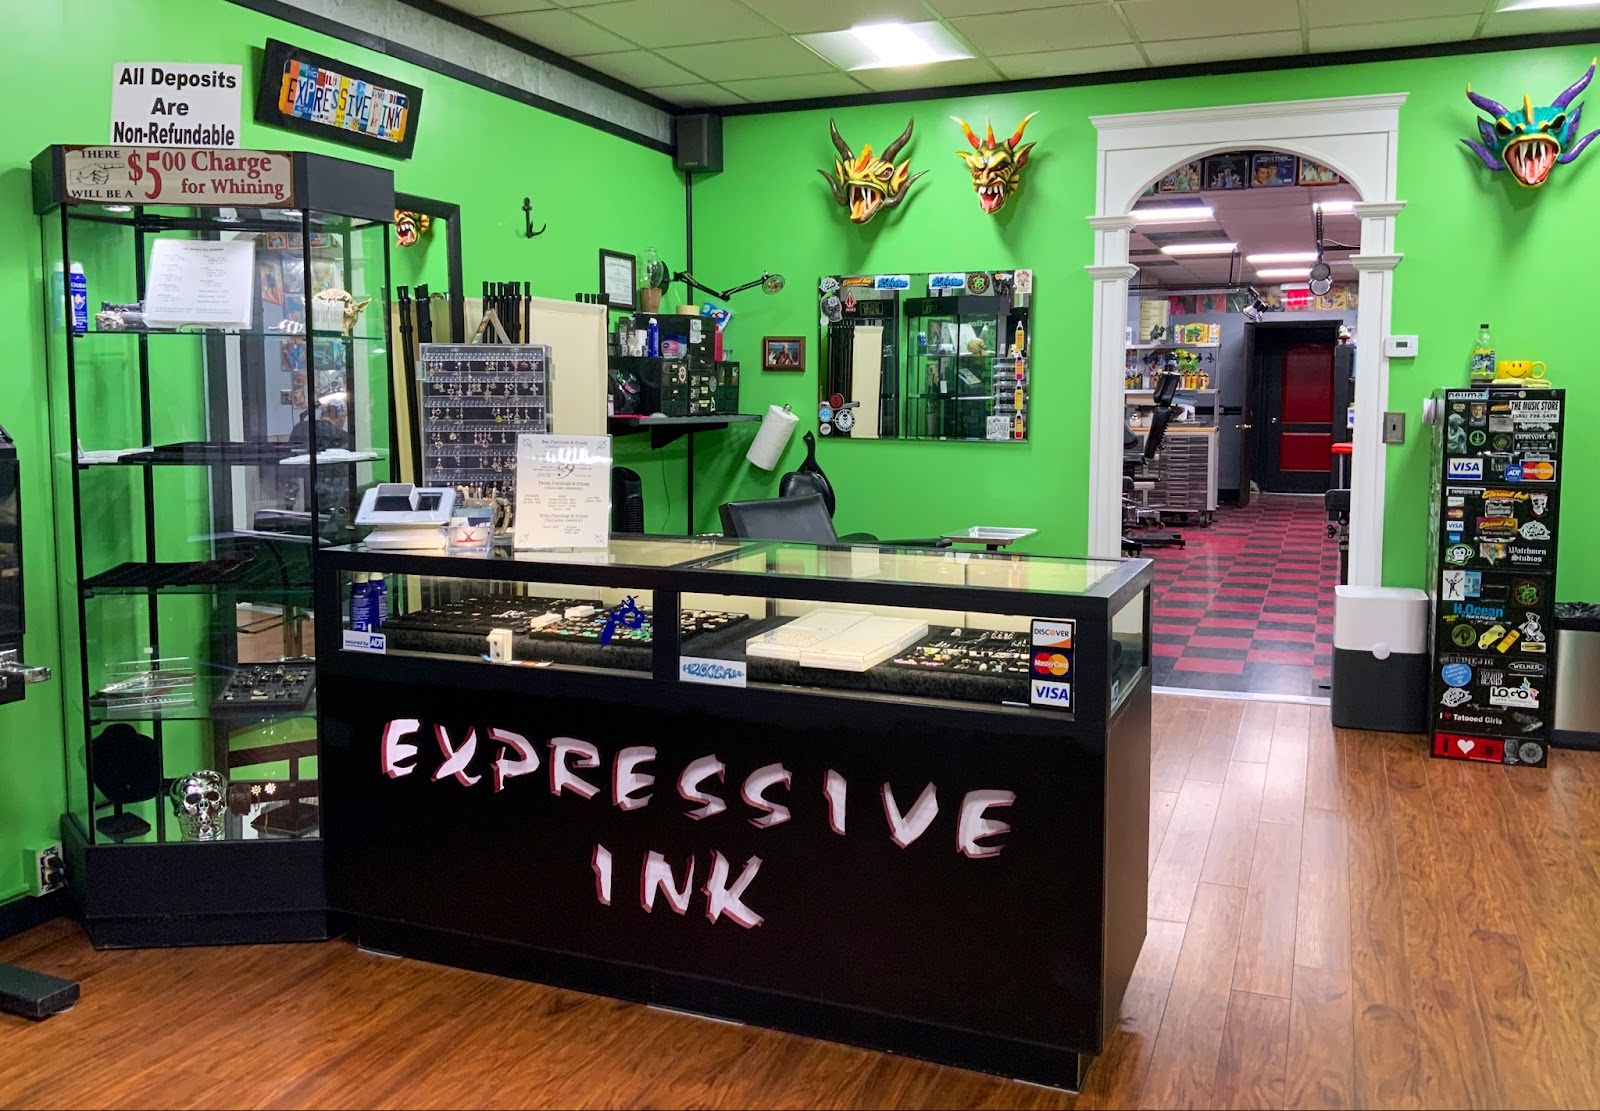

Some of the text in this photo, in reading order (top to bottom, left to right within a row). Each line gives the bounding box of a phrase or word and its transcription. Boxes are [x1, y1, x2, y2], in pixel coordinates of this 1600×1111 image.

[119, 67, 237, 91] All Deposits
[150, 97, 190, 116] Are
[287, 77, 404, 130] EXPRESSIVE INK
[113, 121, 235, 146] Non-Refundable
[80, 149, 121, 159] THERE
[190, 150, 272, 179] Charge
[71, 189, 134, 199] WILL BE A
[181, 178, 285, 200] for Whining
[1448, 391, 1483, 399] neuma
[1511, 401, 1522, 411] THE
[1522, 401, 1540, 411] MUSIC
[1541, 401, 1559, 411] STORE
[1453, 462, 1479, 471] VISA
[1508, 546, 1547, 555] Watchmen
[1034, 628, 1069, 637] DISCOVER
[370, 638, 384, 648] ADT
[1034, 659, 1069, 669] MasterCard
[1034, 685, 1069, 701] VISA
[1484, 716, 1503, 725] Girls
[381, 719, 1016, 859] EXPRESSIVE
[591, 843, 765, 929] INK
